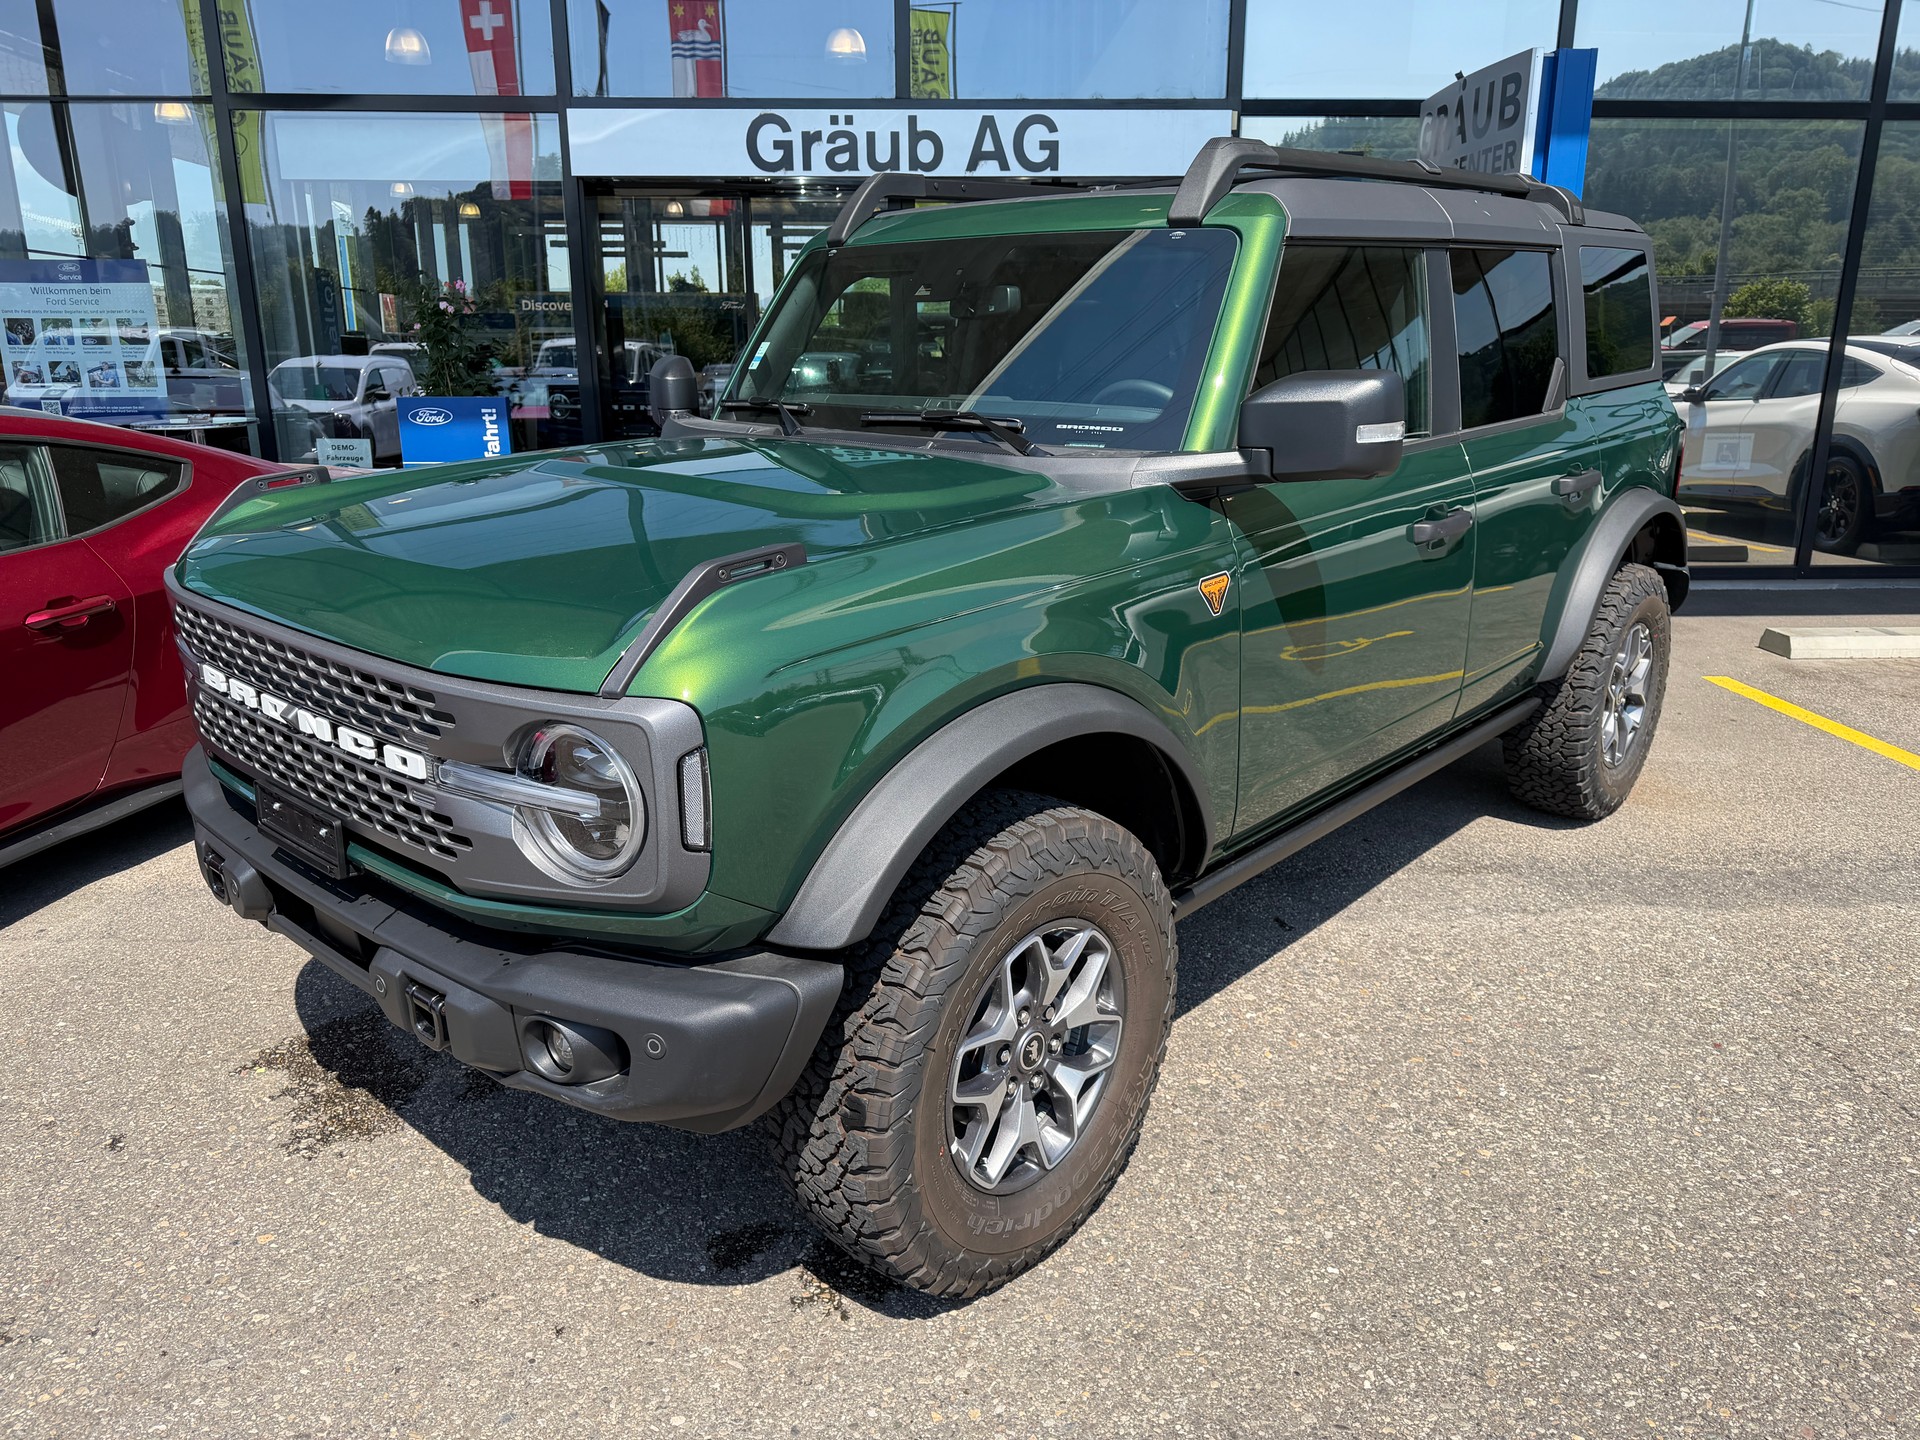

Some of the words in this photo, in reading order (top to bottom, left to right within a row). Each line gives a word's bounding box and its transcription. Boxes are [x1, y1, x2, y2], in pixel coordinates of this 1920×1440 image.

[745, 112, 944, 172] Gräub
[965, 113, 1059, 173] AG
[58, 273, 82, 281] Service
[30, 286, 88, 295] Willkommen
[90, 286, 111, 295] beim
[46, 297, 67, 306] Ford
[69, 297, 100, 306] Service
[521, 299, 572, 312] Discove
[413, 409, 448, 424] Ford
[1056, 424, 1124, 432] BRONCO
[326, 454, 364, 463] Fahrzeuge
[202, 663, 428, 780] BRONCO
